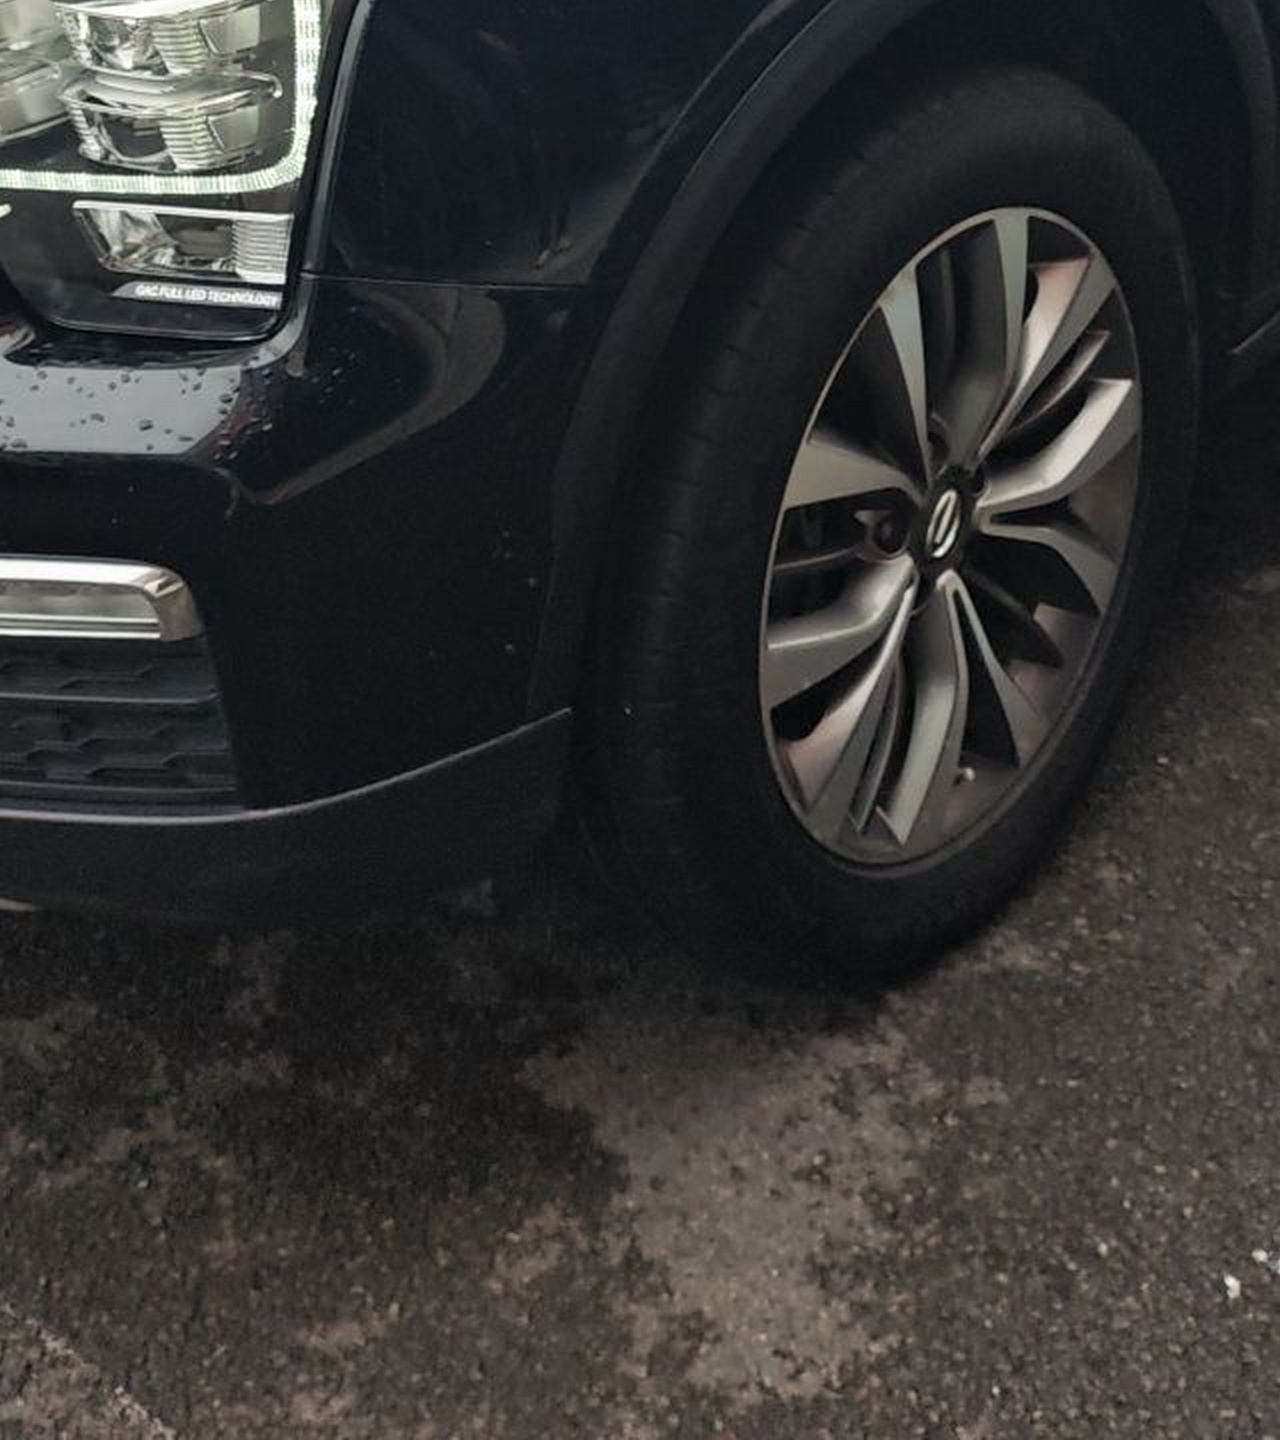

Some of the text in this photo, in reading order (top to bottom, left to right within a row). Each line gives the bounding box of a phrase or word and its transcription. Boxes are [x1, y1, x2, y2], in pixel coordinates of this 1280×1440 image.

[134, 283, 278, 307] GAC FULL LED TECHNOLOGY
